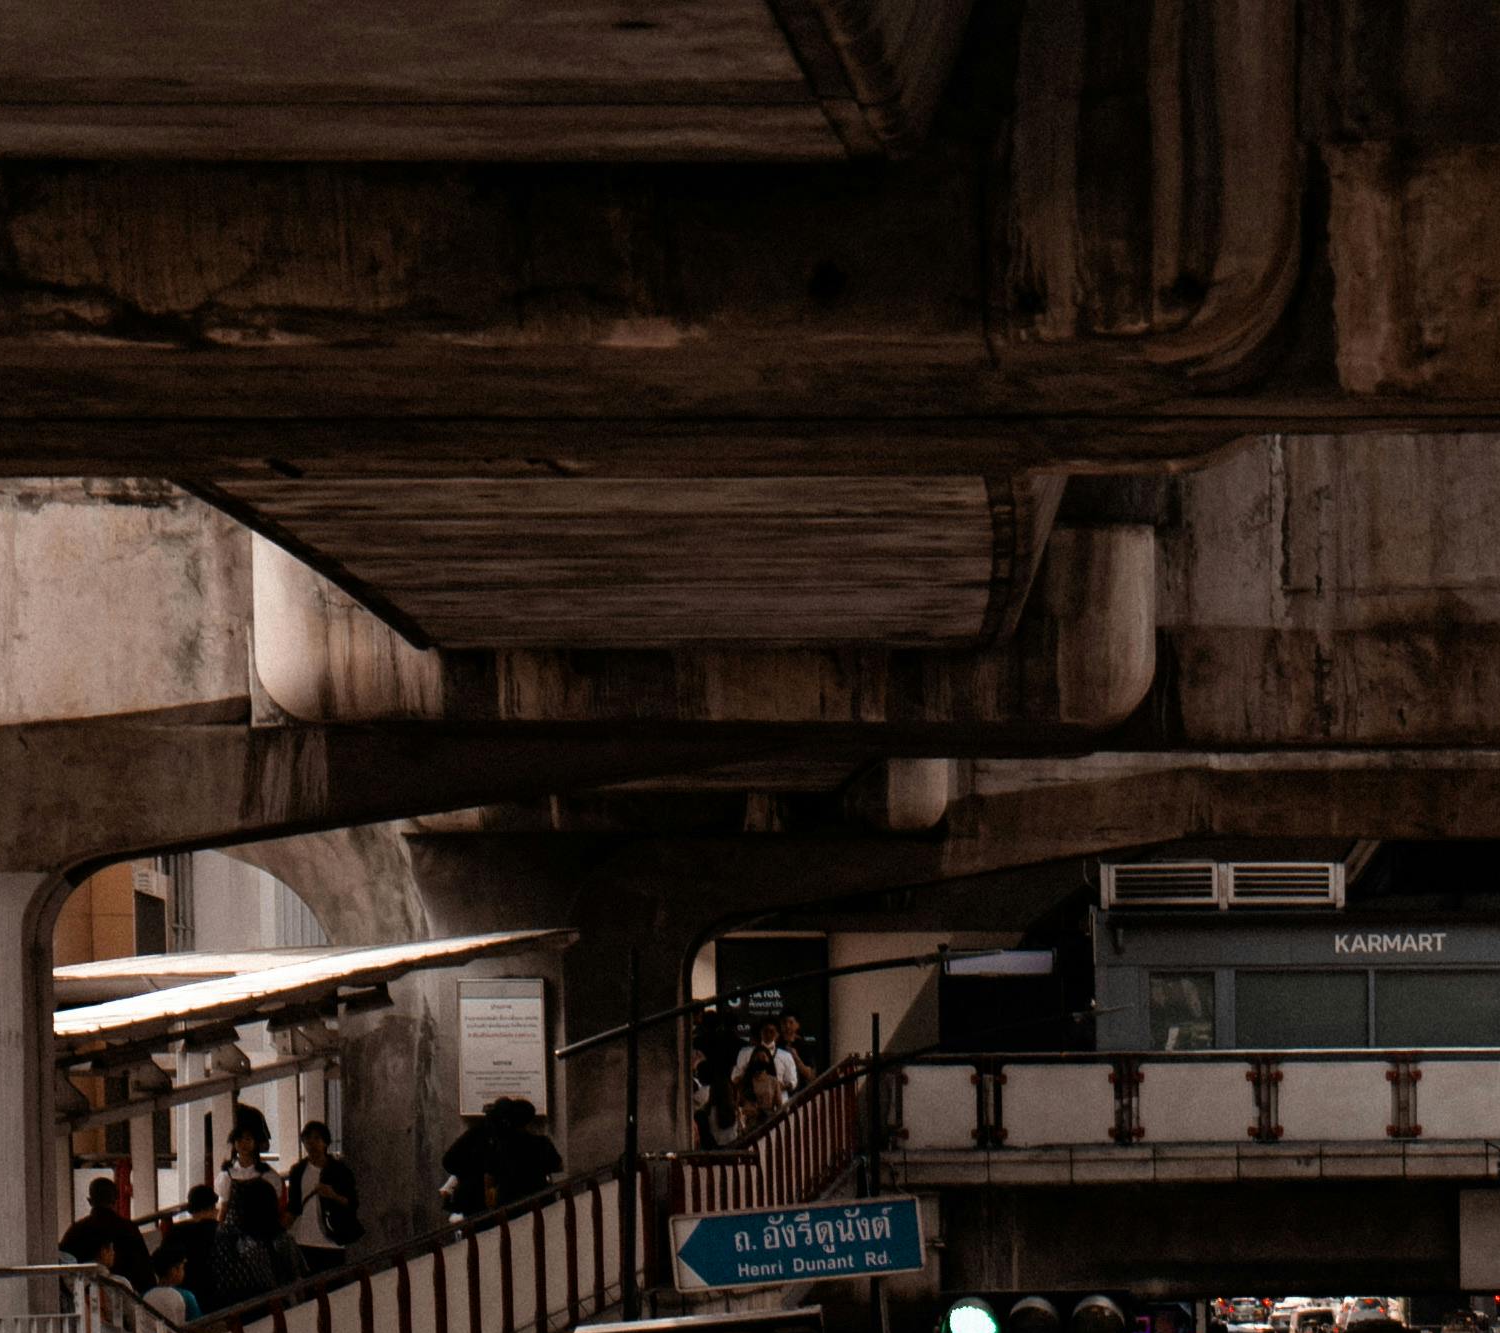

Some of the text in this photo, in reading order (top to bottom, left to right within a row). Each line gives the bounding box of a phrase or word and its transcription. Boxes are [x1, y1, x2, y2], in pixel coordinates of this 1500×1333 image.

[1334, 932, 1447, 953] KARMART
[734, 1206, 893, 1255] ถ. อังรีดูนังต์
[737, 1251, 893, 1280] Henri Dunant Rd.
